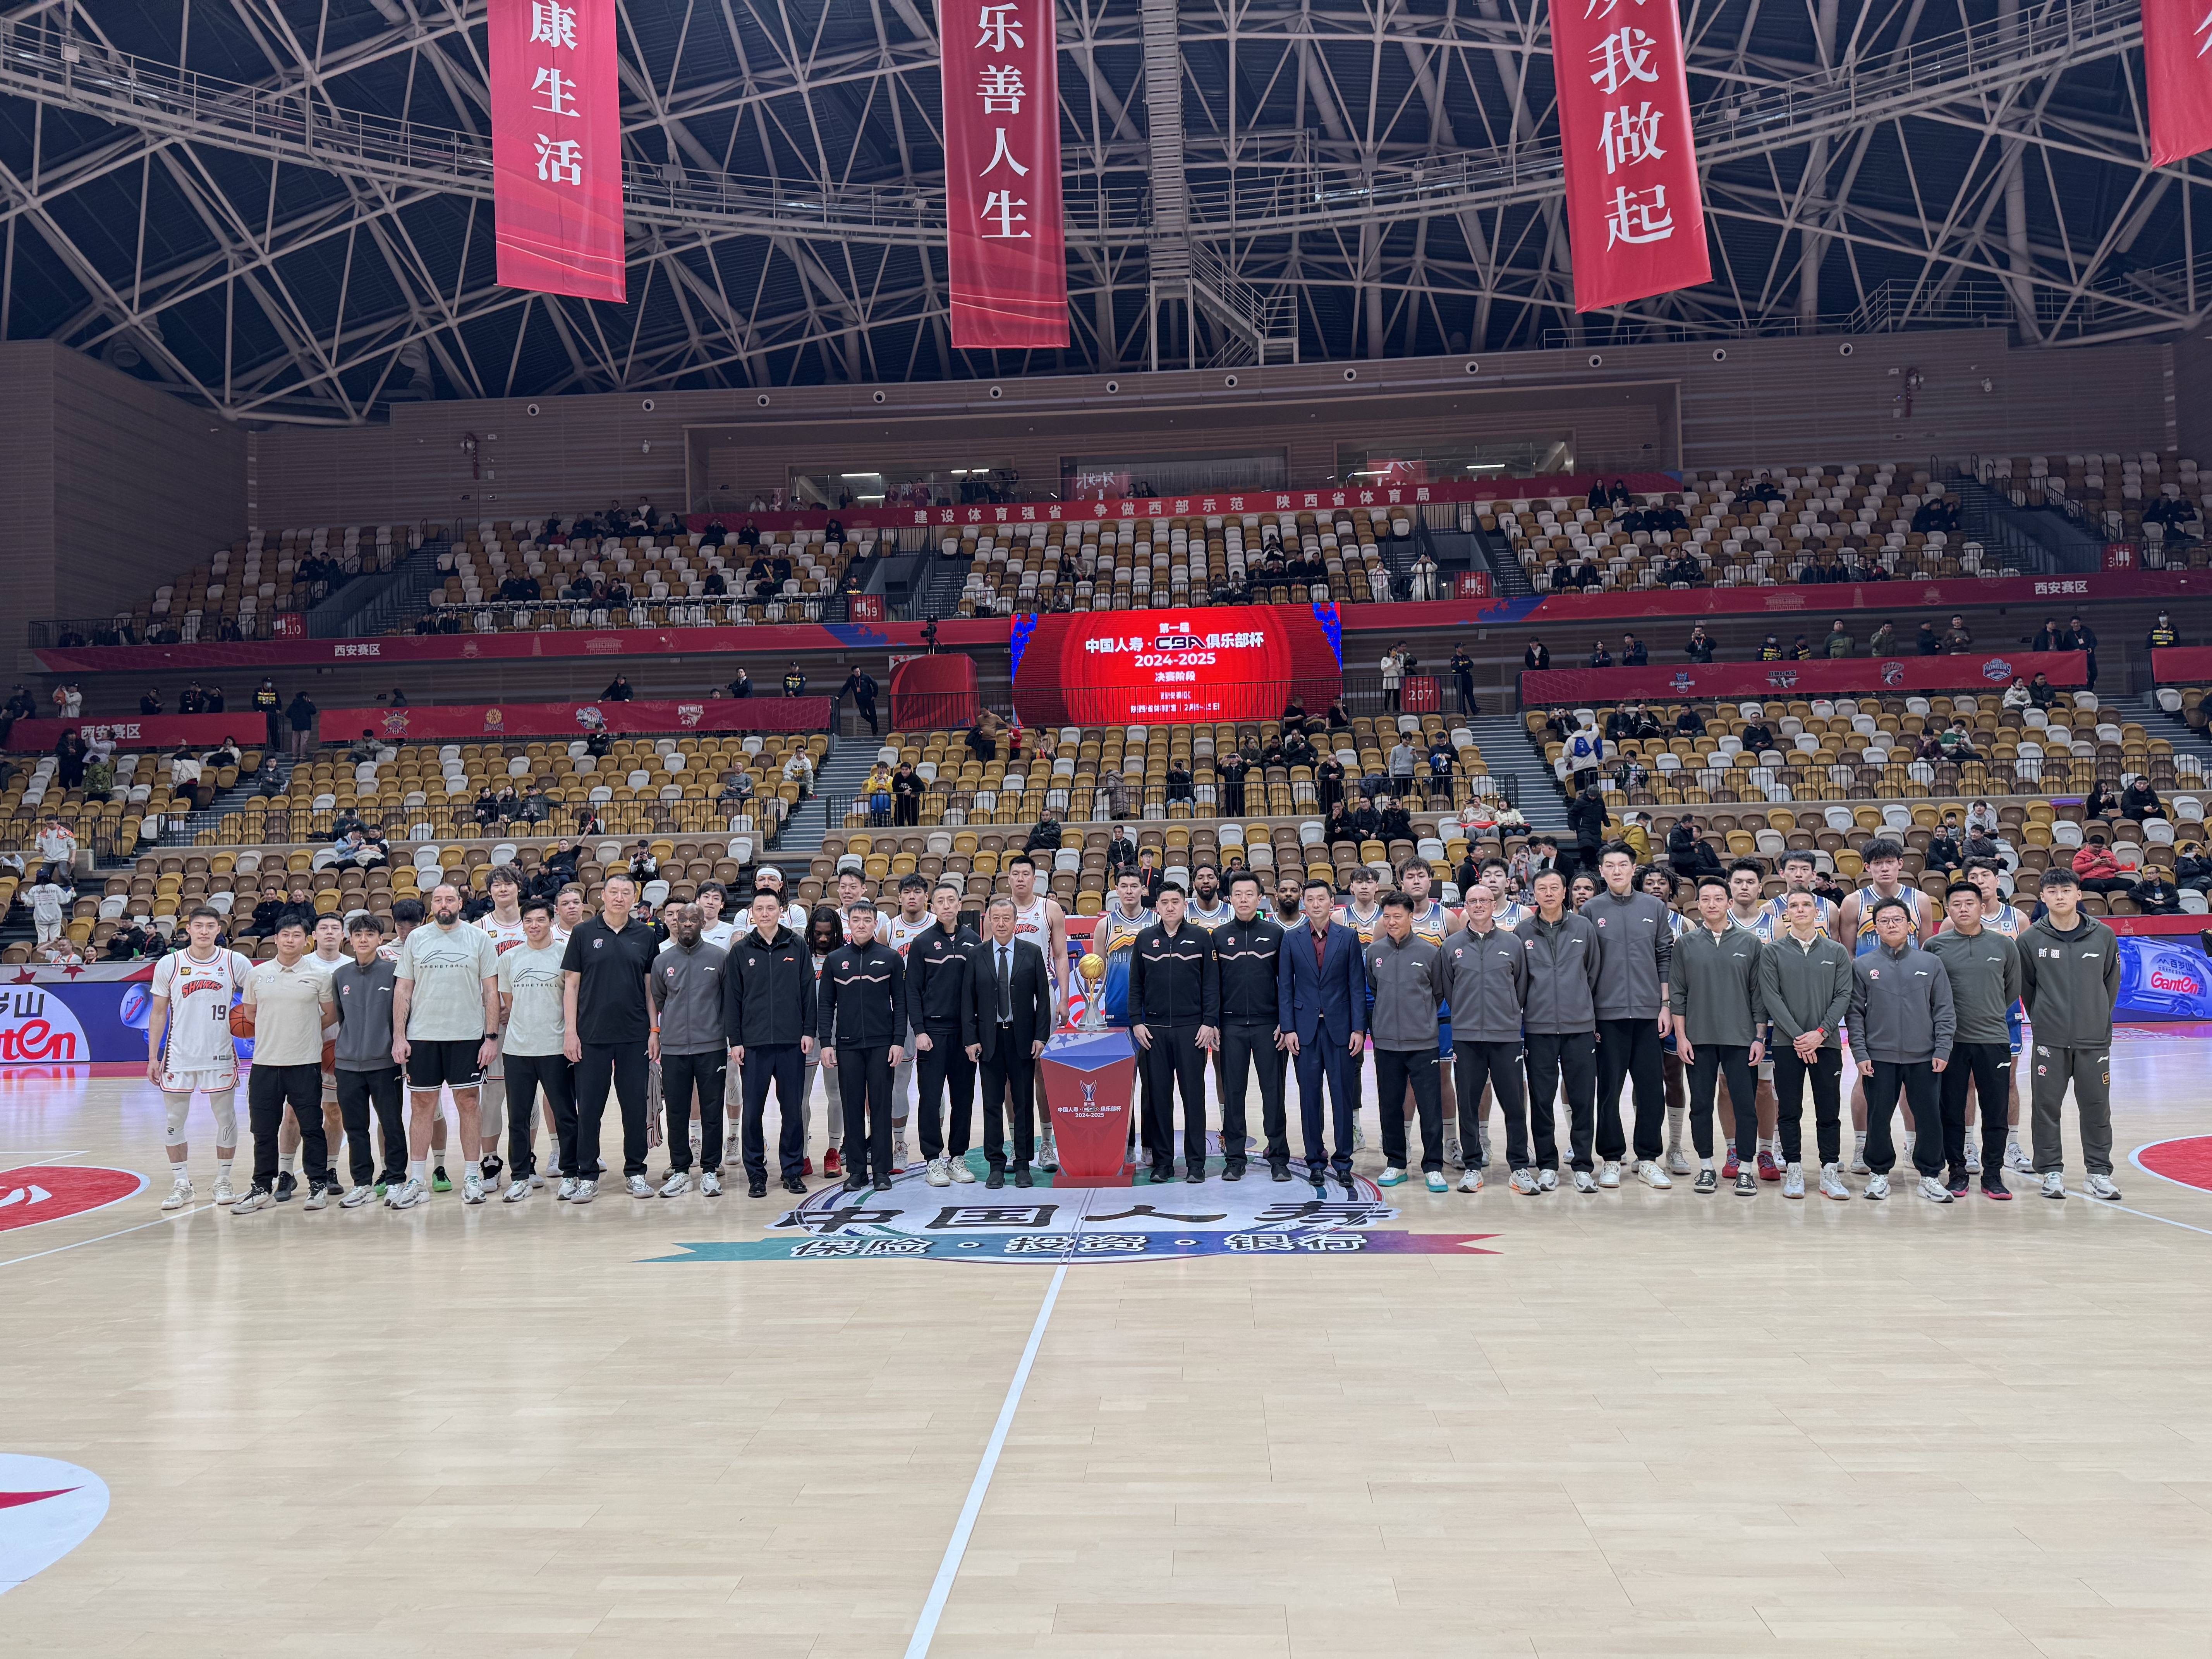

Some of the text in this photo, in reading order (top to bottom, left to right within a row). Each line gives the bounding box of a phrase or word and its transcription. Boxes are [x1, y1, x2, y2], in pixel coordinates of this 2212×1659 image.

[529, 0, 582, 186] 康生活
[974, 3, 1032, 239] 乐善人生
[914, 488, 1430, 524] 建设体育强省 争做西部示范 陕西省体育局
[2034, 580, 2088, 595] 西安赛区
[1159, 622, 1190, 634] 第一届
[334, 644, 381, 657] 西安赛区
[1134, 653, 1216, 667] 2024-2025
[1155, 671, 1196, 682] 决赛阶段
[1408, 690, 1433, 701] 207
[2170, 958, 2193, 971] 百岁山
[182, 979, 223, 998] SHARKS
[2151, 971, 2198, 994] Ganten
[211, 1005, 227, 1020] 19
[0, 1019, 76, 1060] ten
[775, 1200, 1393, 1232] 中国人寿
[790, 1234, 1368, 1257] 保险 投资 银行
